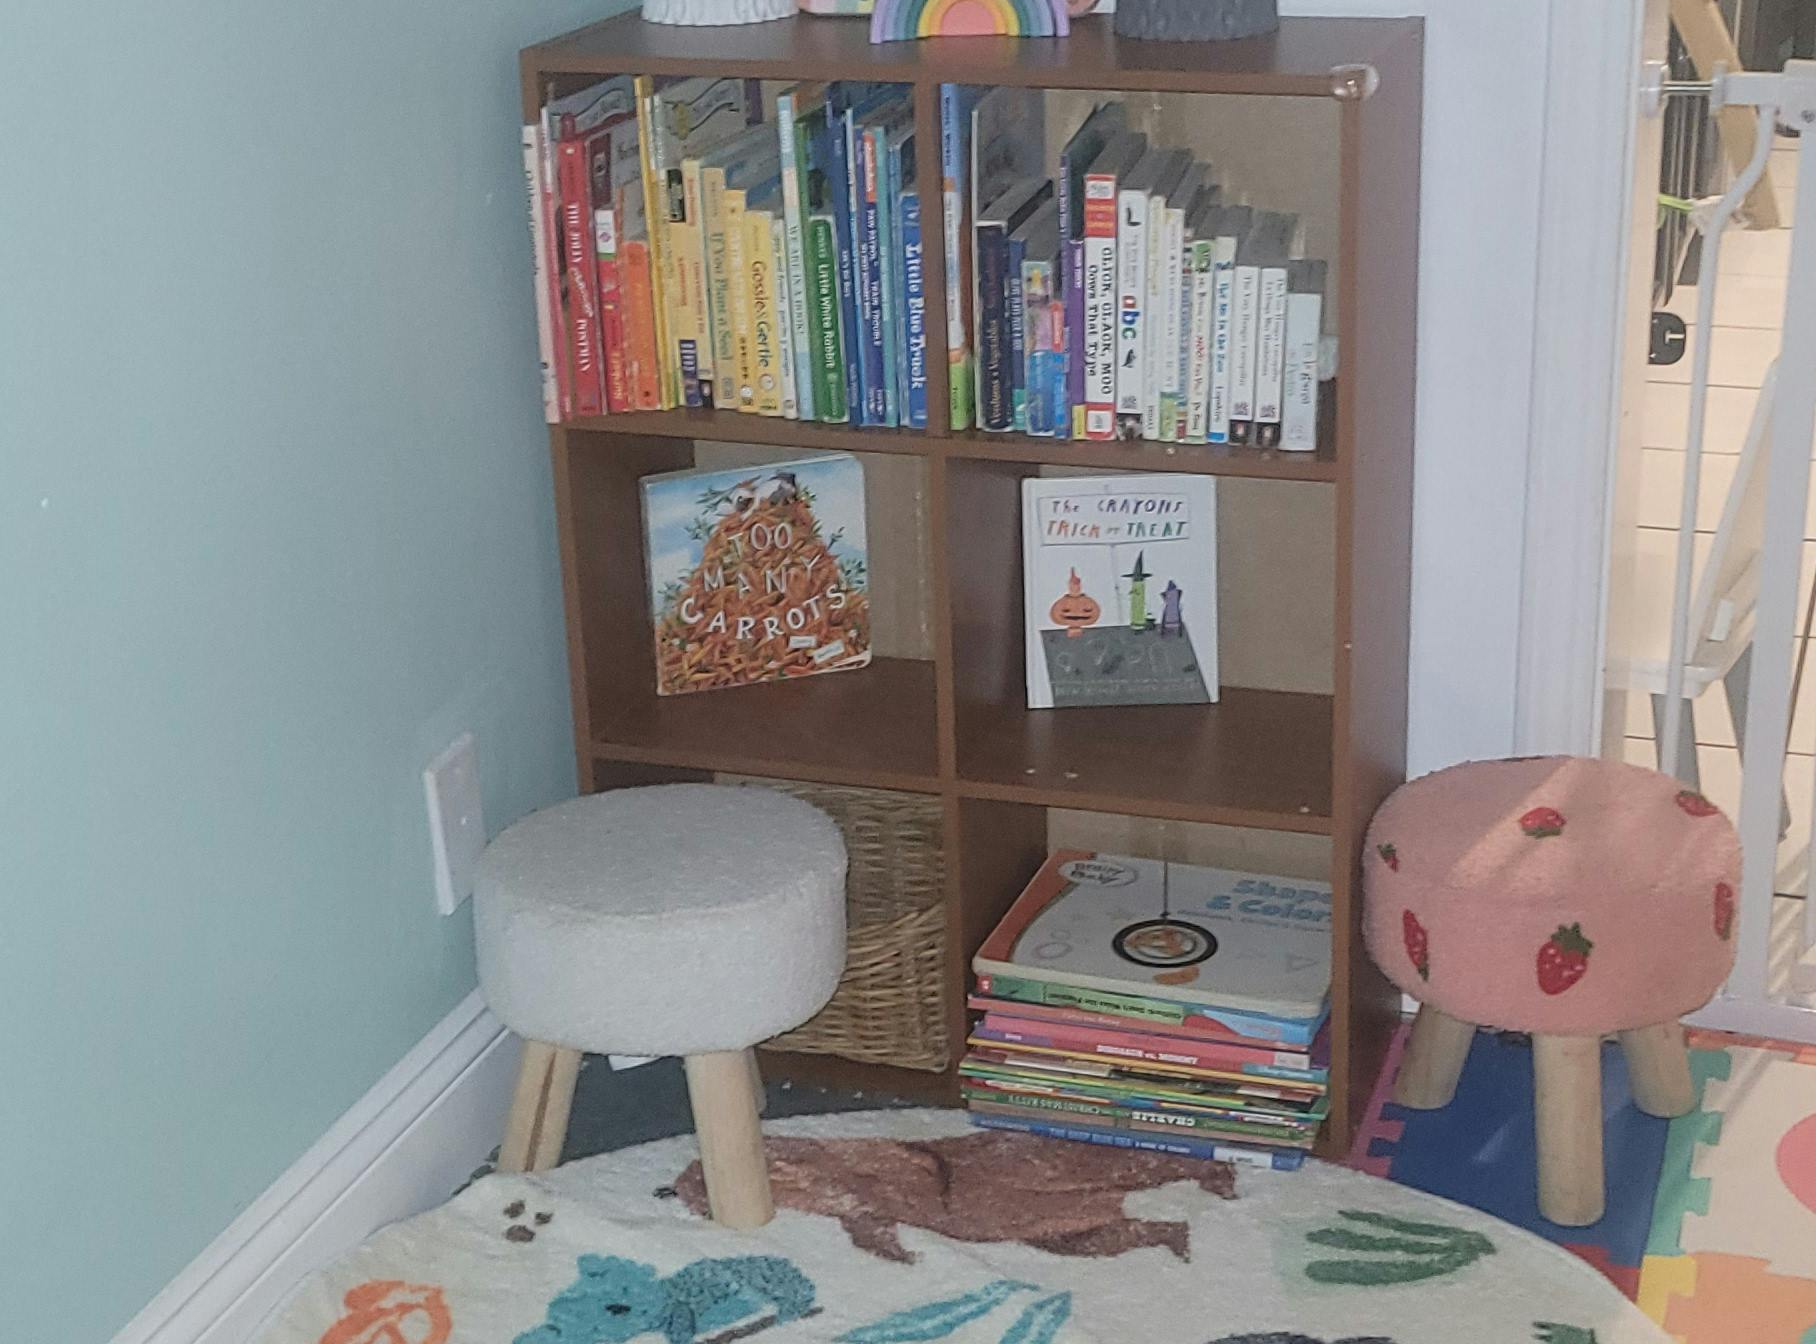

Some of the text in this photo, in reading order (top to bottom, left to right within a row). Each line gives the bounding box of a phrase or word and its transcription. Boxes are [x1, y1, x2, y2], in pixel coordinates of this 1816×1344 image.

[817, 263, 837, 369] Little White Rabbit
[905, 243, 926, 389] Little Blue Truck
[1084, 264, 1099, 377] Cows That Type
[1100, 247, 1113, 395] CLICK, CLACK, MOO
[1121, 294, 1141, 340] abc
[756, 321, 774, 368] Gertie
[1047, 519, 1188, 538] TRICK or TREAT
[1052, 498, 1184, 515] The CRAYONS
[728, 521, 793, 560] TOO
[703, 554, 822, 599] MANY
[680, 583, 847, 641] CARROTS
[1233, 879, 1332, 905] Shape
[1238, 898, 1332, 923] Color
[1131, 1110, 1196, 1127] CHARLIE
